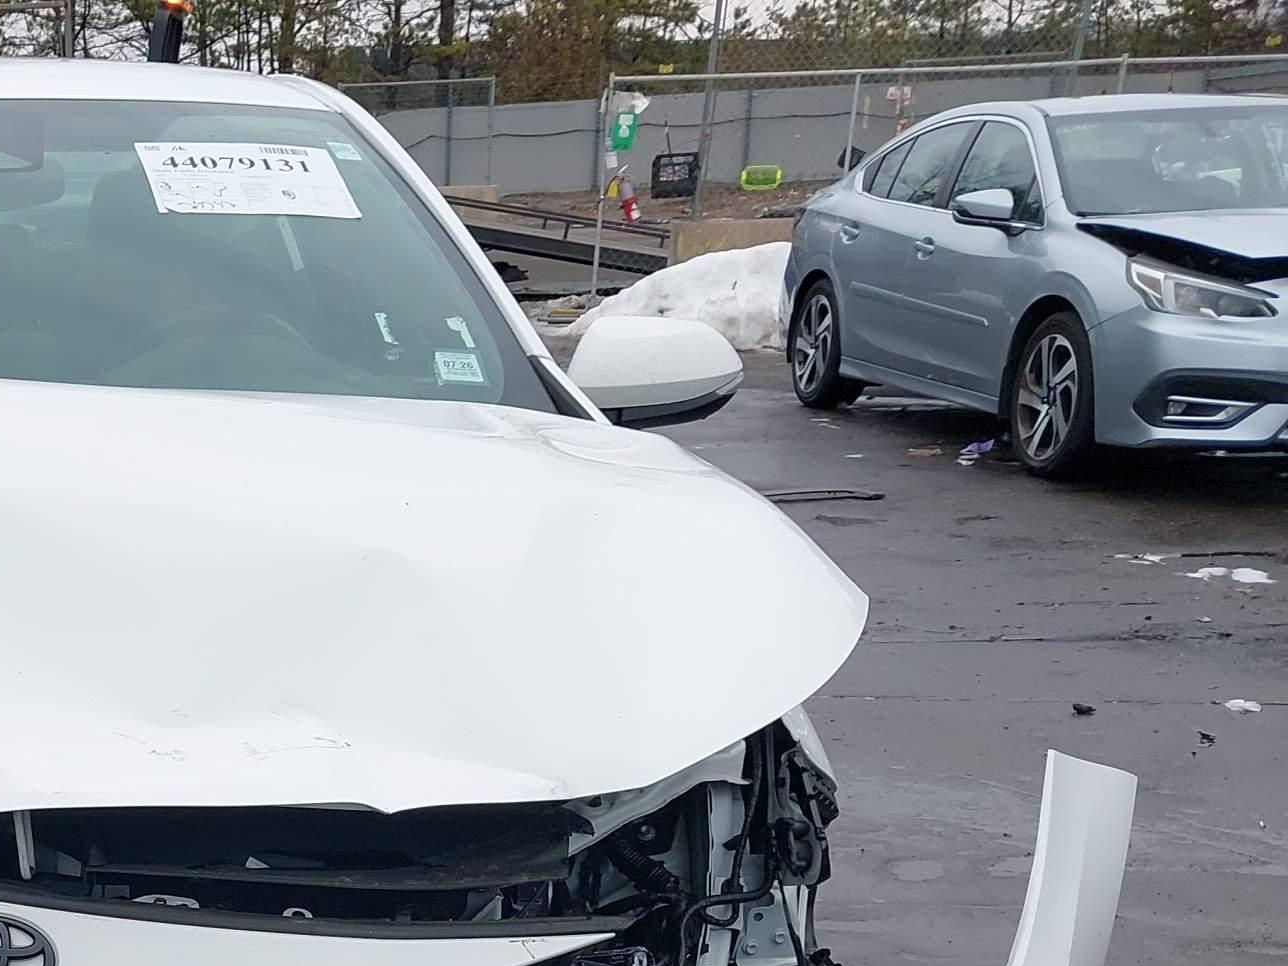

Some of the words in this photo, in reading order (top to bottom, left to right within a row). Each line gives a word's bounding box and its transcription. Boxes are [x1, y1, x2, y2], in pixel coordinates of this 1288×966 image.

[161, 155, 312, 174] 44079131
[443, 360, 456, 369] 07
[459, 361, 474, 369] 26
